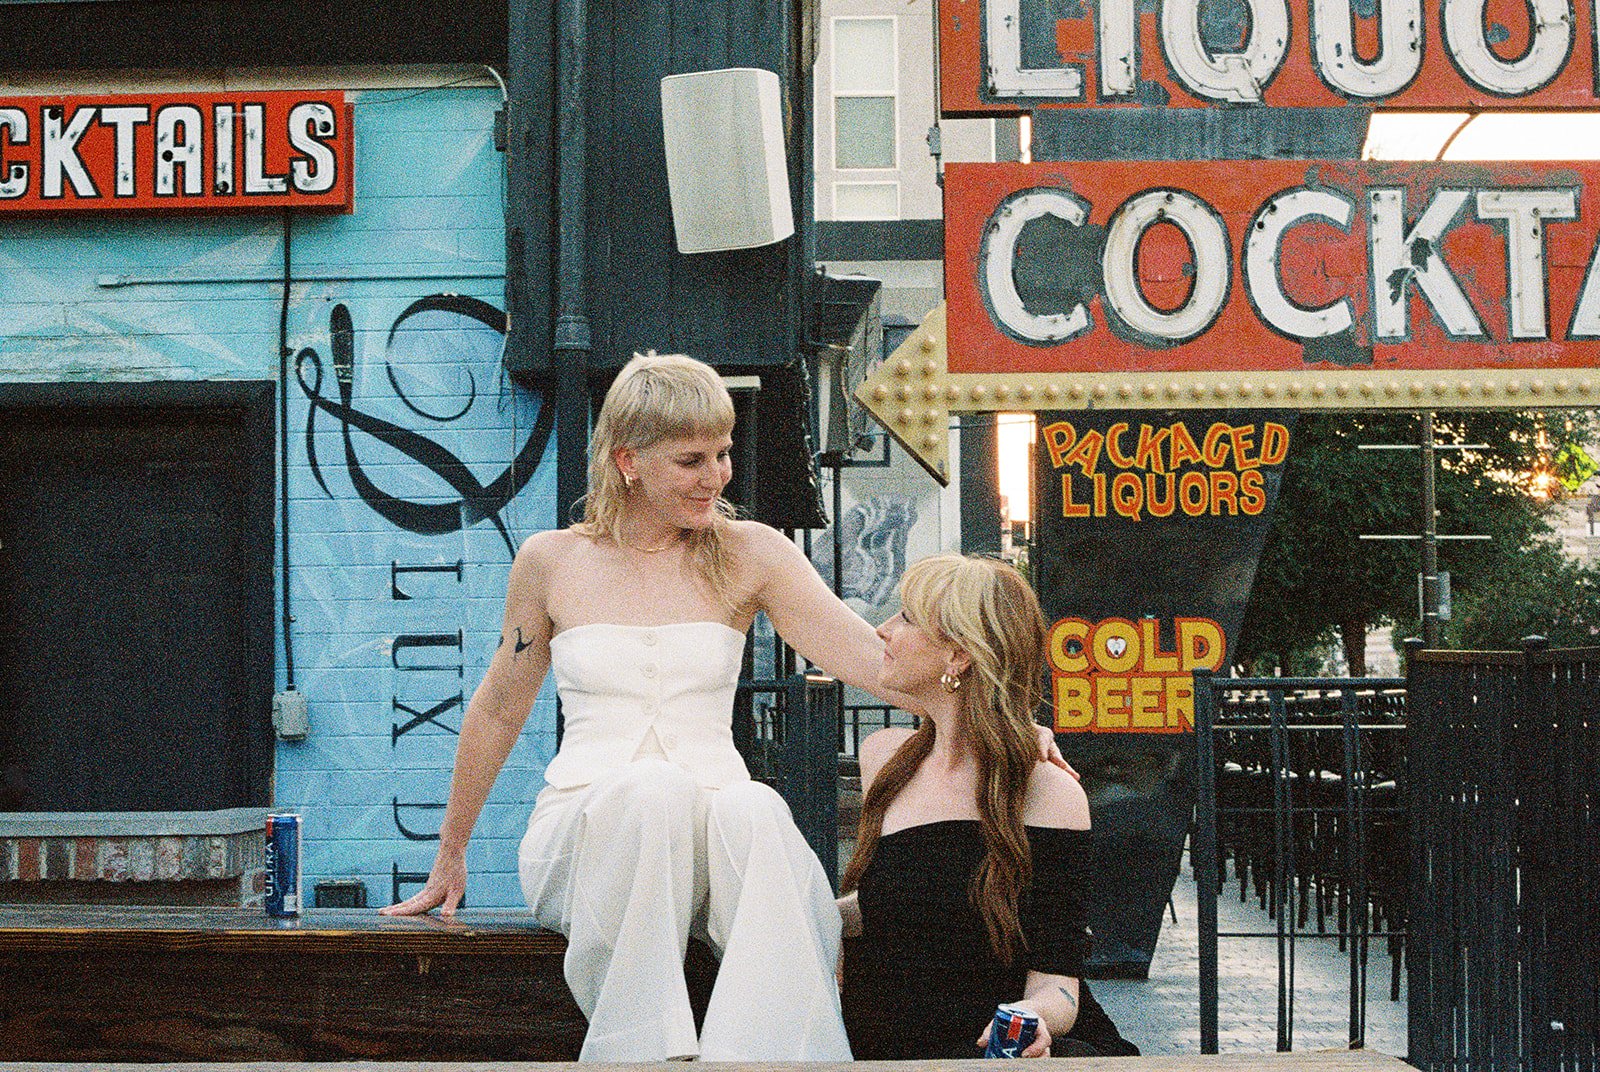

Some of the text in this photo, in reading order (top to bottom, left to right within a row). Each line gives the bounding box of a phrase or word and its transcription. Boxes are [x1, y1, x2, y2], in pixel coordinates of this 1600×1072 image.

[984, 0, 1600, 102] LIQUO
[984, 187, 1600, 341] COCKT
[1042, 421, 1290, 478] PACKAGED
[1061, 470, 1266, 522] LIQUORS
[1047, 617, 1226, 673] COLD
[1053, 674, 1195, 733] BEER
